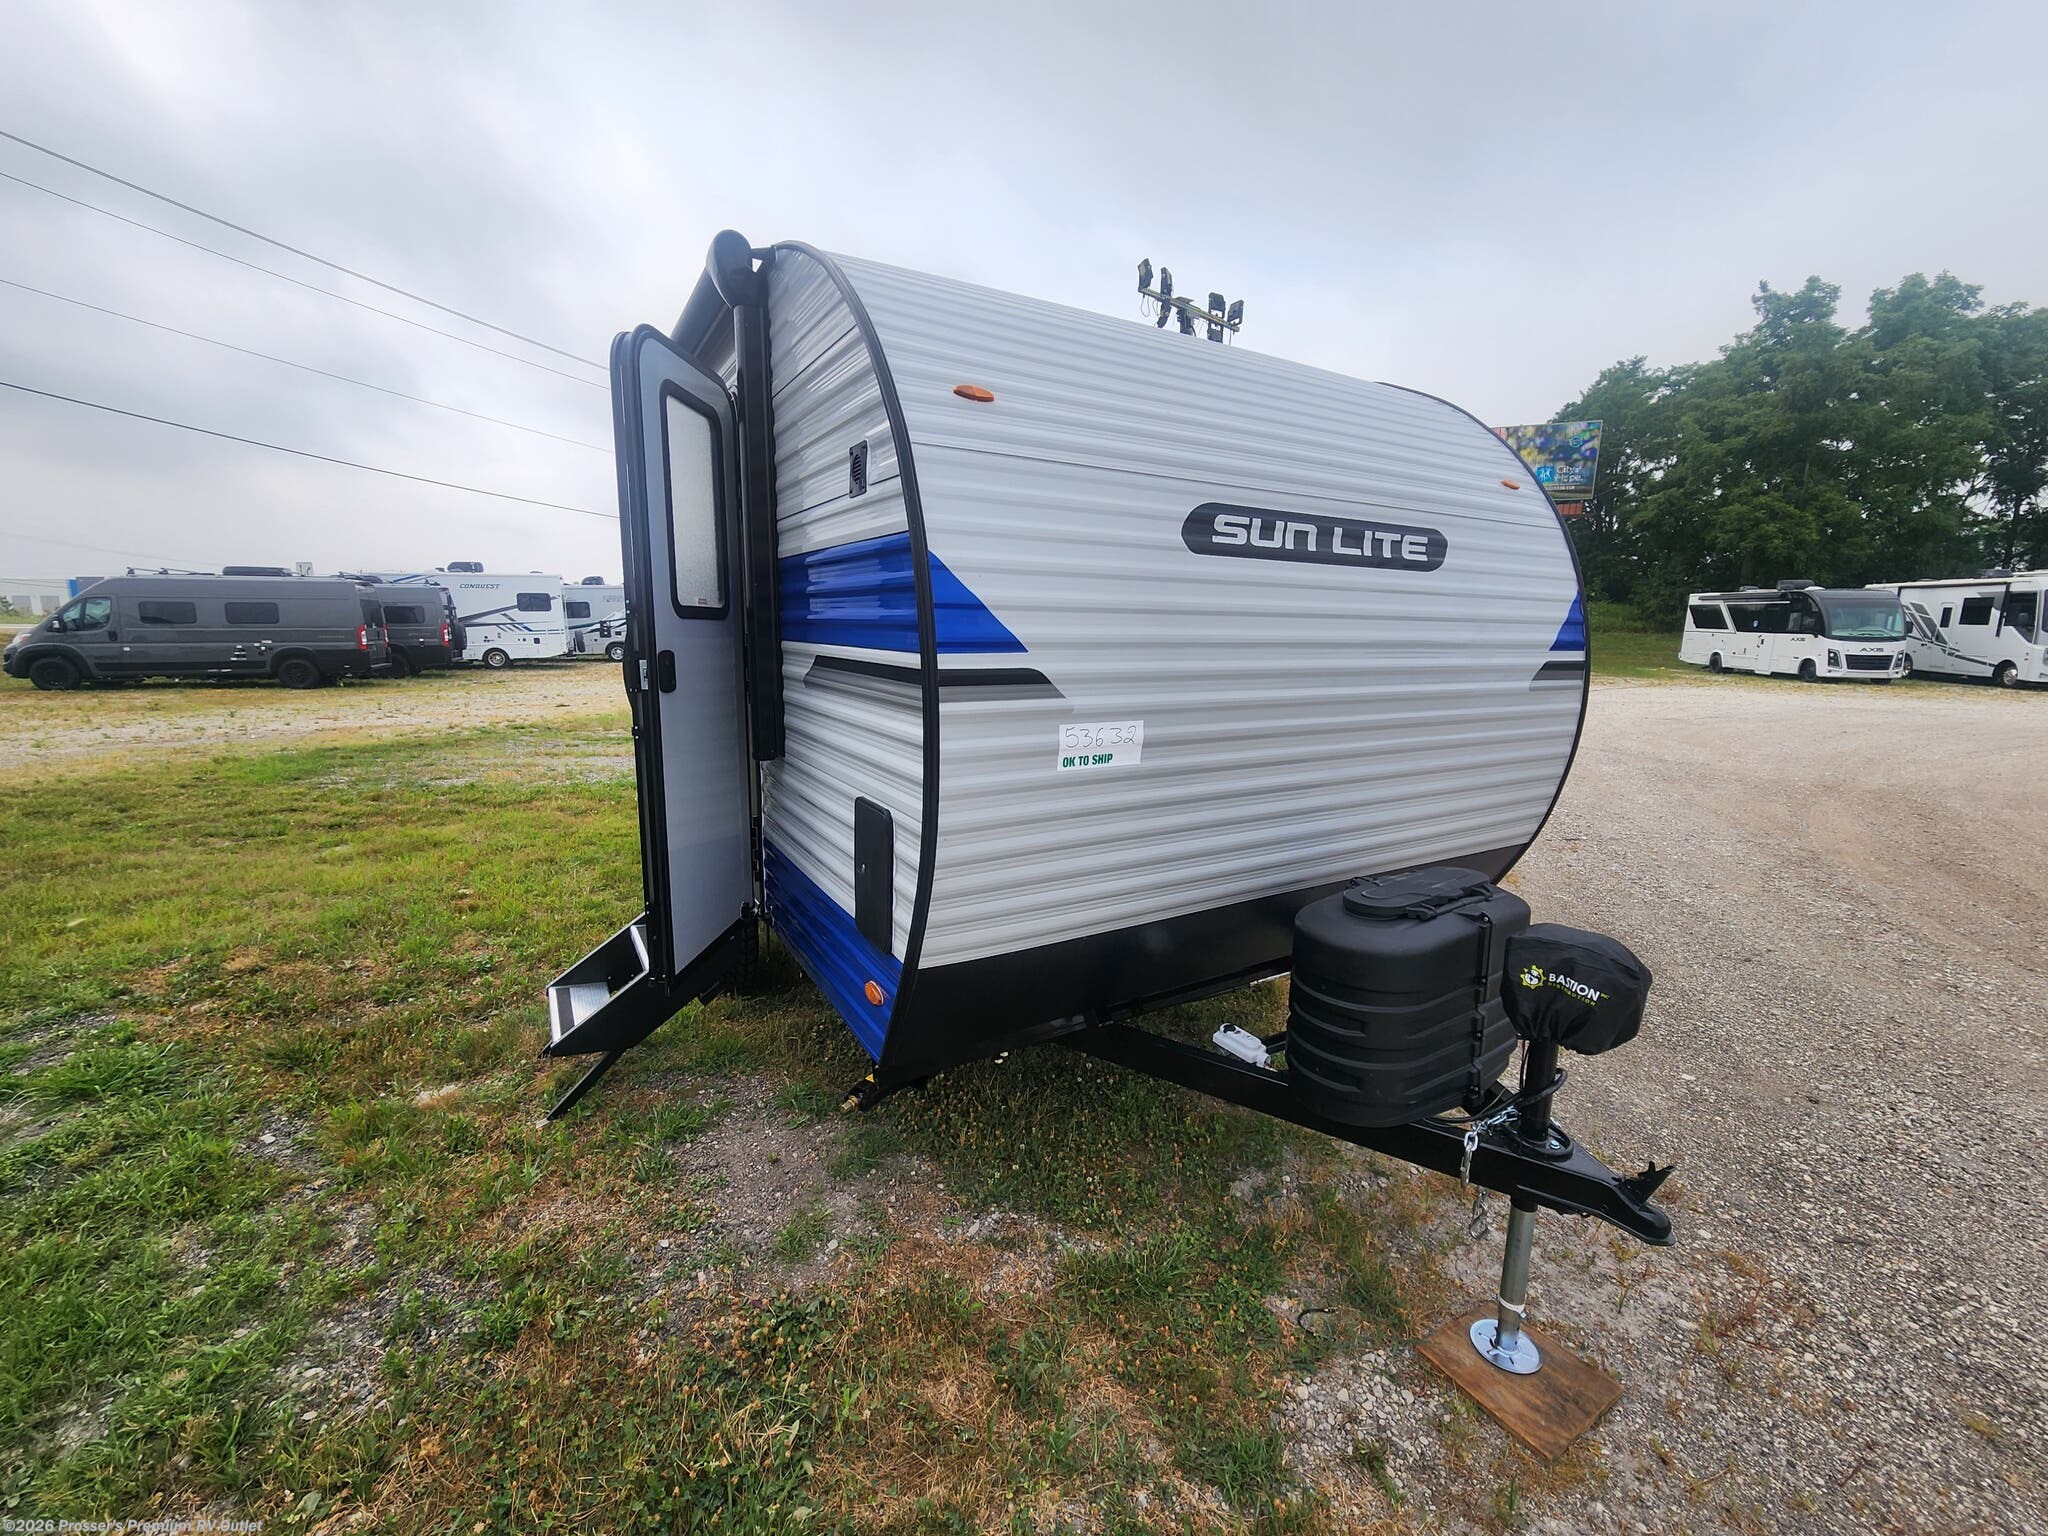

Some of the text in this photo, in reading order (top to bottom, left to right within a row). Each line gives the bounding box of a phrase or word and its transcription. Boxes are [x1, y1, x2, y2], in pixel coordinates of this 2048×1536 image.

[1212, 514, 1429, 562] SUN LITE
[1065, 725, 1137, 748] 53632
[1062, 753, 1114, 768] OK TO SHIP
[1548, 973, 1600, 1001] BASTION
